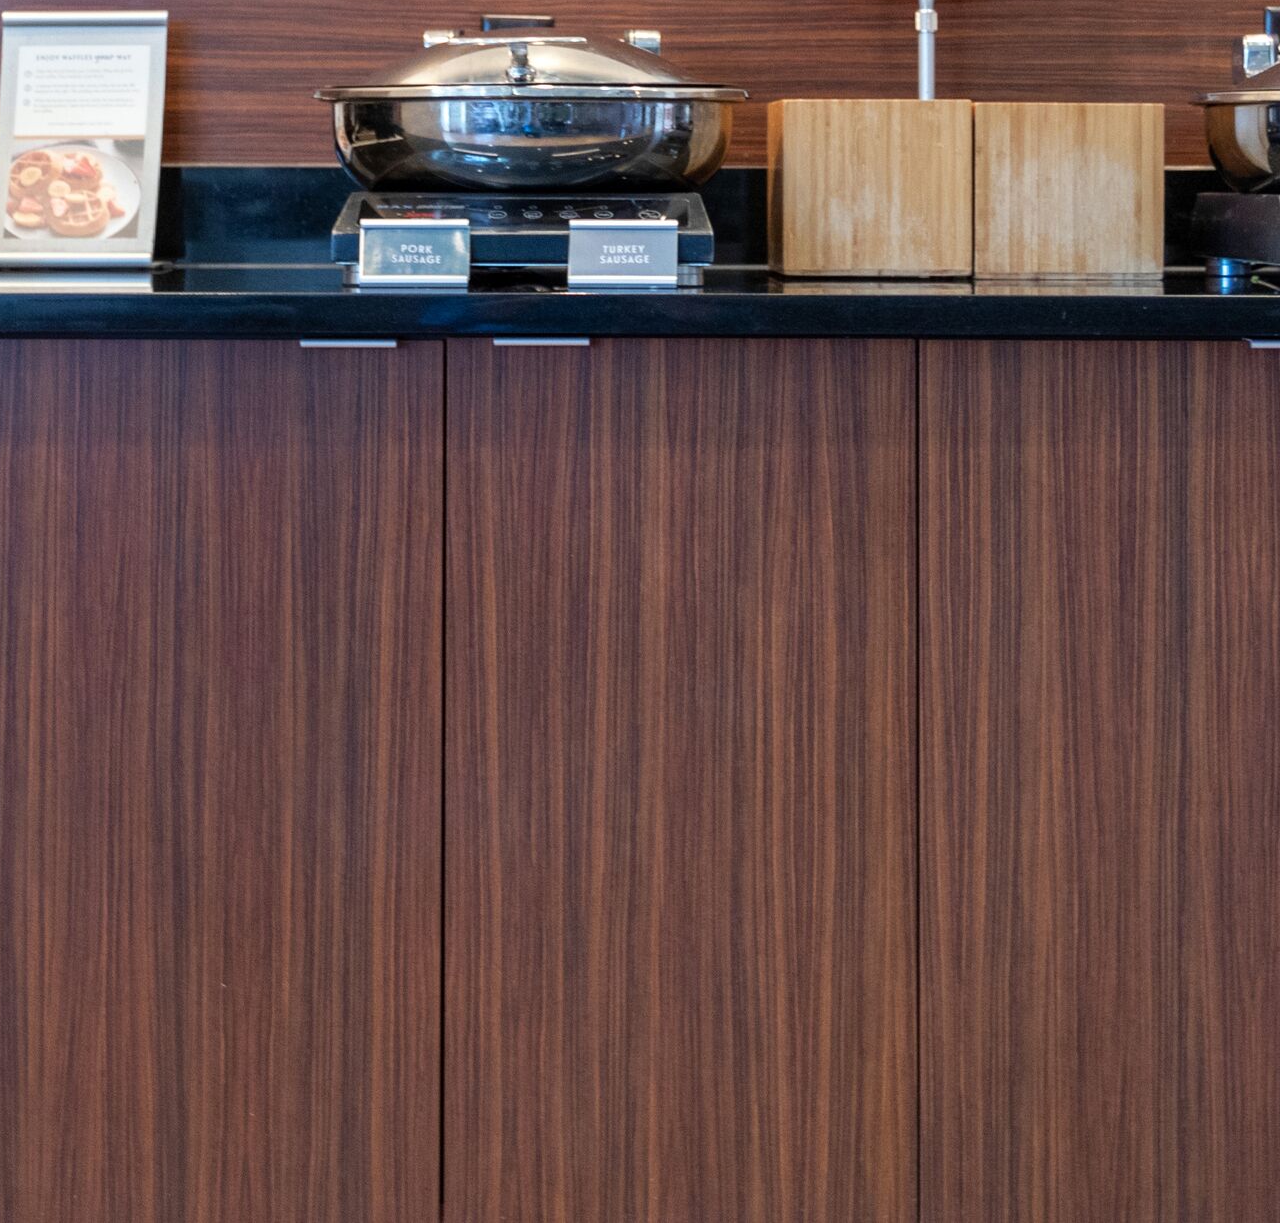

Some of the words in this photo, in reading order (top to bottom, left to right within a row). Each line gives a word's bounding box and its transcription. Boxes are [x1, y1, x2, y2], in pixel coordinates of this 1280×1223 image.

[401, 244, 432, 254] PORK
[602, 244, 645, 254] TURKEY
[391, 254, 442, 265] SAUSAGE
[599, 254, 650, 265] SAUSAGE
